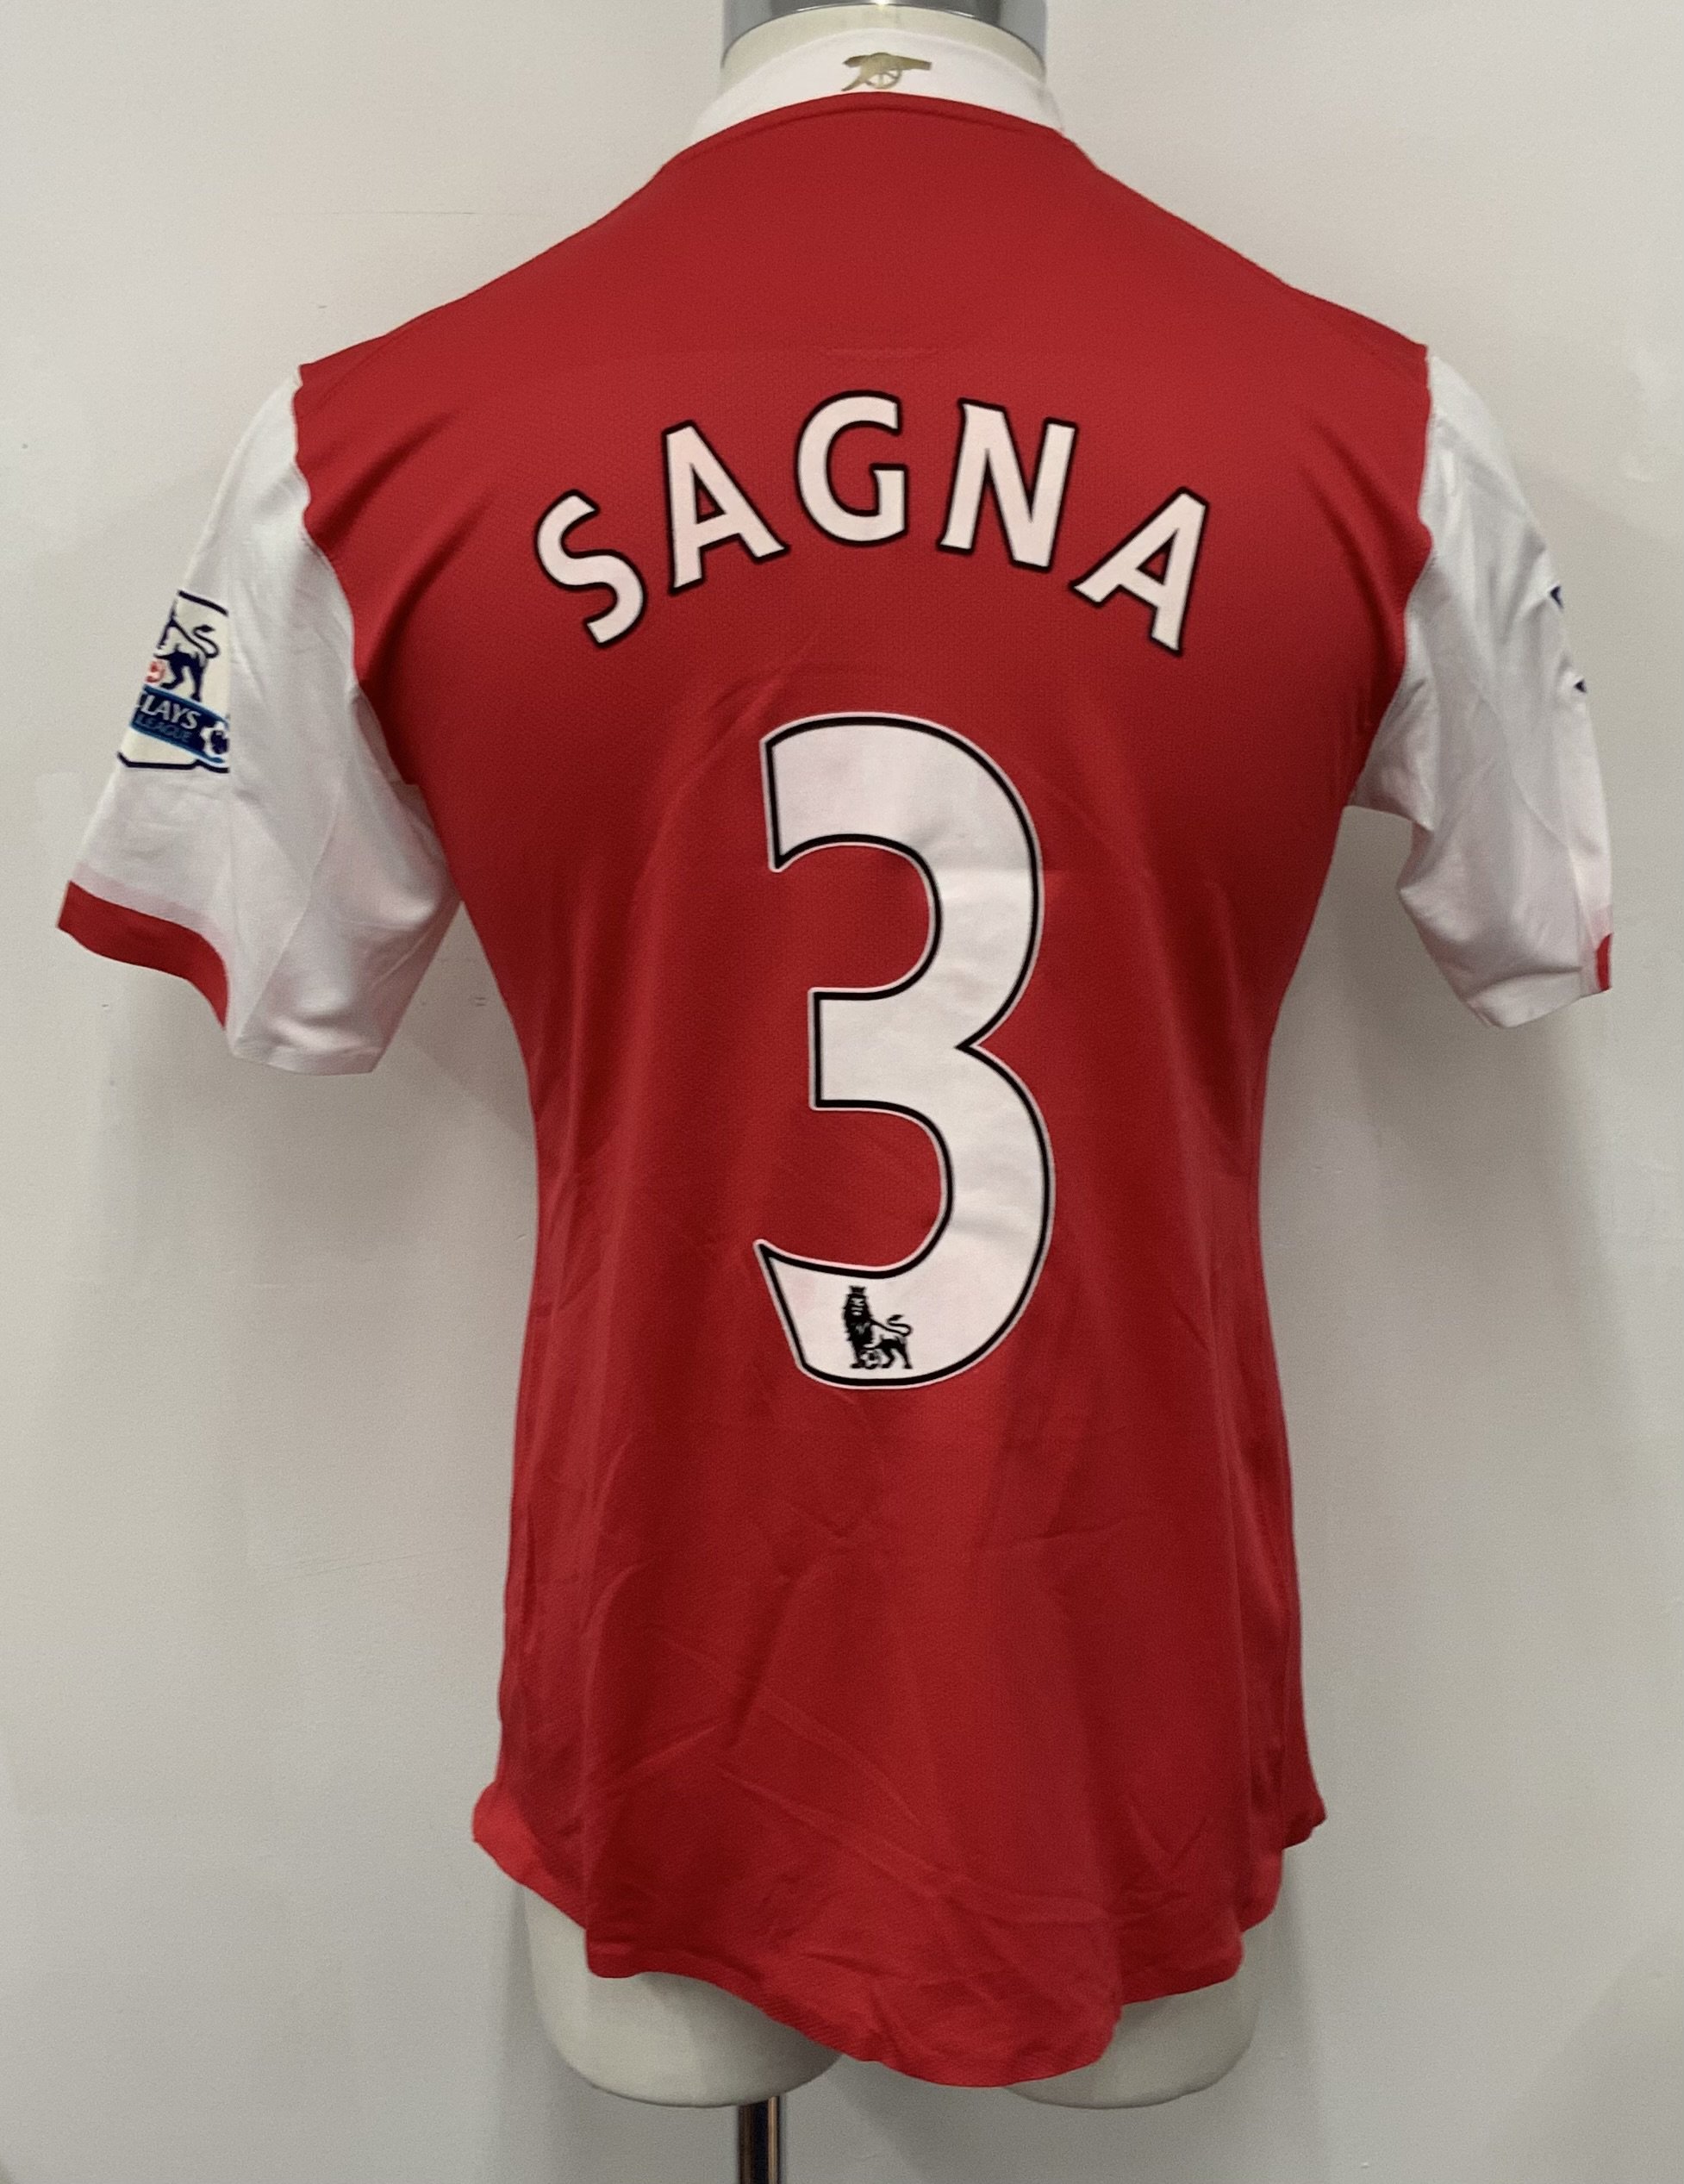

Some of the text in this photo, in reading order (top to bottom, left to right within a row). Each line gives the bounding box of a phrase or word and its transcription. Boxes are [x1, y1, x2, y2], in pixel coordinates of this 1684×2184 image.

[533, 389, 1208, 657] SAGNA
[138, 692, 202, 730] LAYS
[752, 712, 1056, 1390] 3
